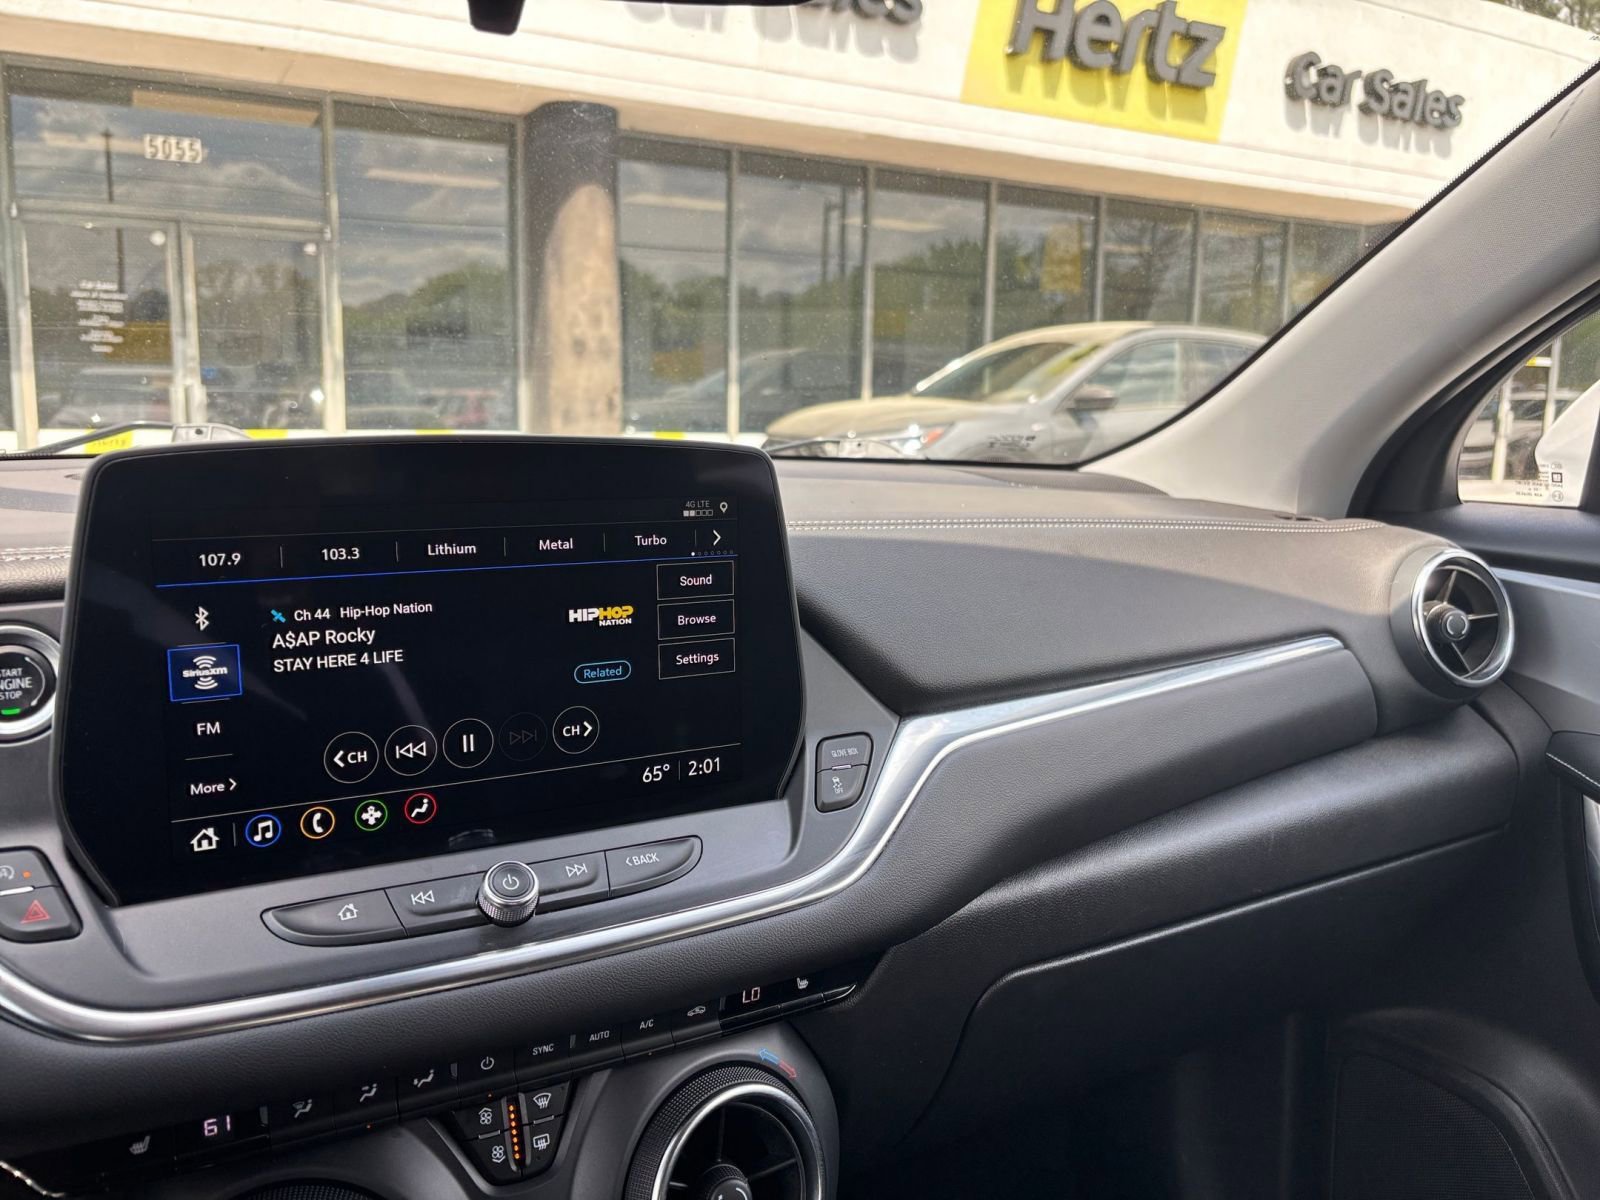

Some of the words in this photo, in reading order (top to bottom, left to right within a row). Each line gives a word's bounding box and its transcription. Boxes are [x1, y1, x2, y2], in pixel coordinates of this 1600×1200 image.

[1005, 0, 1226, 90] Hertz
[1285, 51, 1362, 108] Car
[1358, 69, 1465, 129] Sales
[149, 136, 201, 162] 5055
[685, 500, 696, 508] 4G
[697, 500, 711, 508] LTE
[539, 538, 574, 551] Metal
[634, 534, 668, 547] Turbo
[321, 547, 361, 561] 103.3
[427, 542, 477, 556] Lithium
[199, 552, 242, 567] 107.9
[679, 574, 713, 587] Sound
[294, 609, 312, 622] Ch
[314, 608, 331, 620] 44
[340, 604, 390, 619] Hip-Hop
[393, 602, 433, 615] Nation
[598, 618, 632, 627] NATION
[677, 614, 717, 626] Browse
[272, 631, 321, 650] A$AP
[326, 627, 376, 645] Rocky
[273, 658, 313, 673] STAY
[316, 653, 357, 669] HERE
[360, 653, 370, 667] 4
[373, 650, 404, 665] LIFE
[675, 652, 720, 666] Settings
[0, 668, 22, 677] TART
[583, 667, 622, 680] Related
[196, 722, 221, 735] FM
[562, 725, 580, 737] CH
[347, 751, 368, 764] CH
[642, 763, 670, 783] 65°
[688, 757, 721, 777] 2:01
[190, 782, 225, 796] More
[632, 853, 659, 866] BACK
[639, 1018, 654, 1030] A/C
[589, 1030, 610, 1042] AUTO
[532, 1043, 554, 1056] SYNC
[203, 1115, 232, 1136] 61
